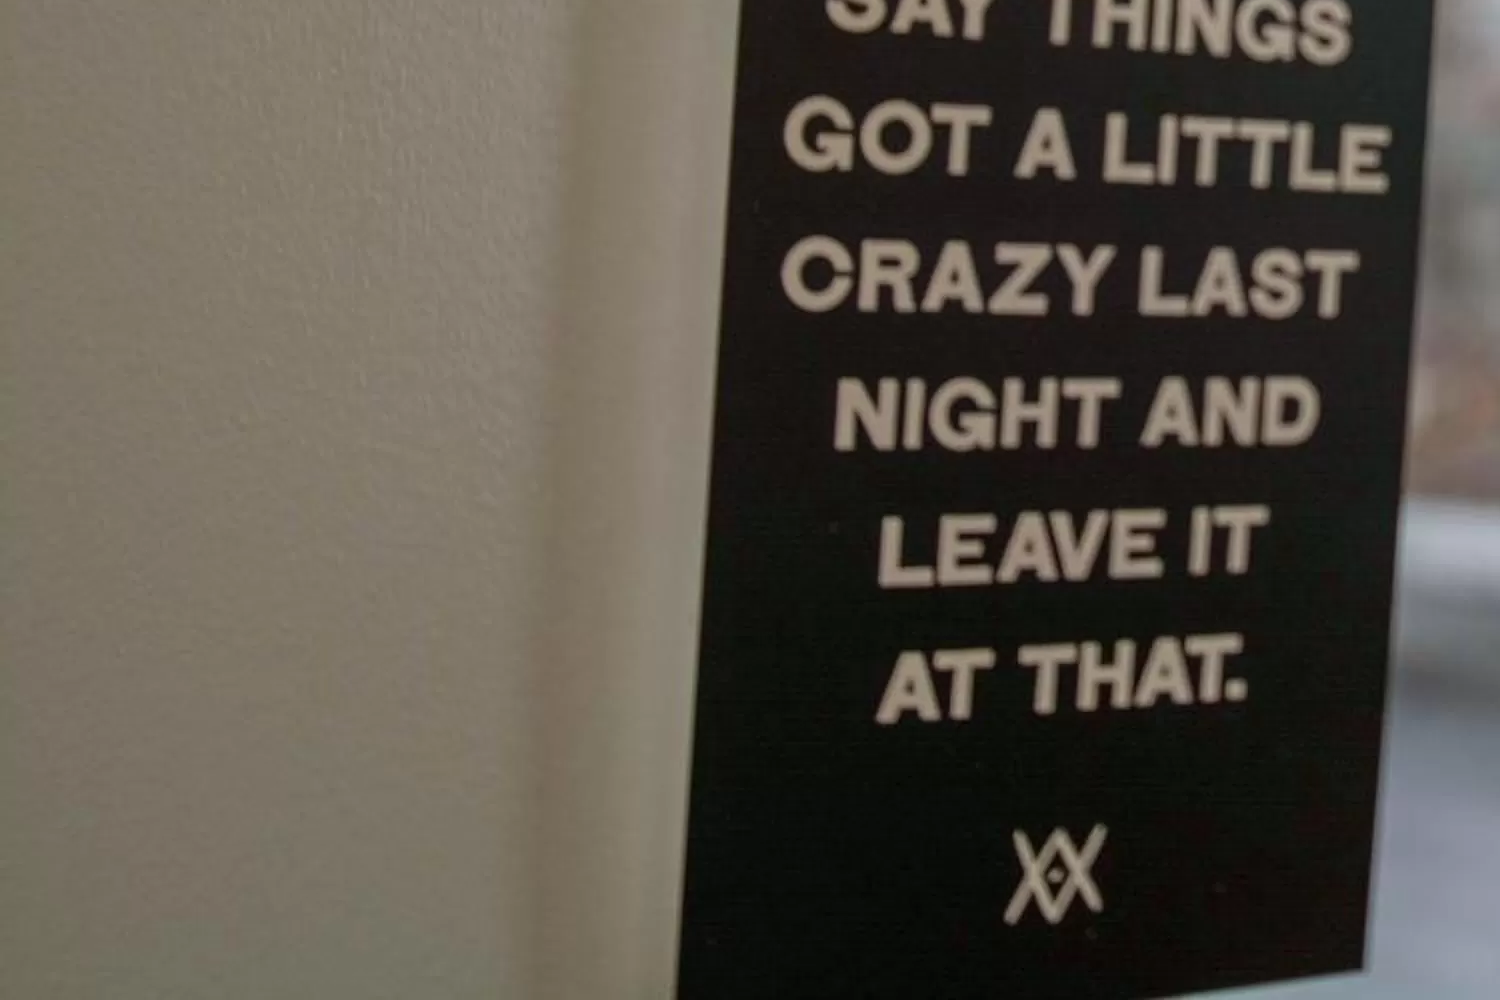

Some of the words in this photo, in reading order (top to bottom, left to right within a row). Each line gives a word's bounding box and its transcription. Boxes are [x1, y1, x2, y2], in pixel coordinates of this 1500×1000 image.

[783, 96, 991, 175] GOT
[1014, 109, 1075, 180] A
[1103, 113, 1391, 193] LITTLE
[781, 236, 1115, 316] CRAZY
[1139, 247, 1360, 318] LAST
[835, 378, 1121, 450] NIGHT
[1140, 377, 1319, 447] AND
[877, 509, 1166, 587] LEAVE
[1189, 506, 1270, 575] IT
[876, 649, 995, 724] AT
[1017, 634, 1247, 713] THAT.
